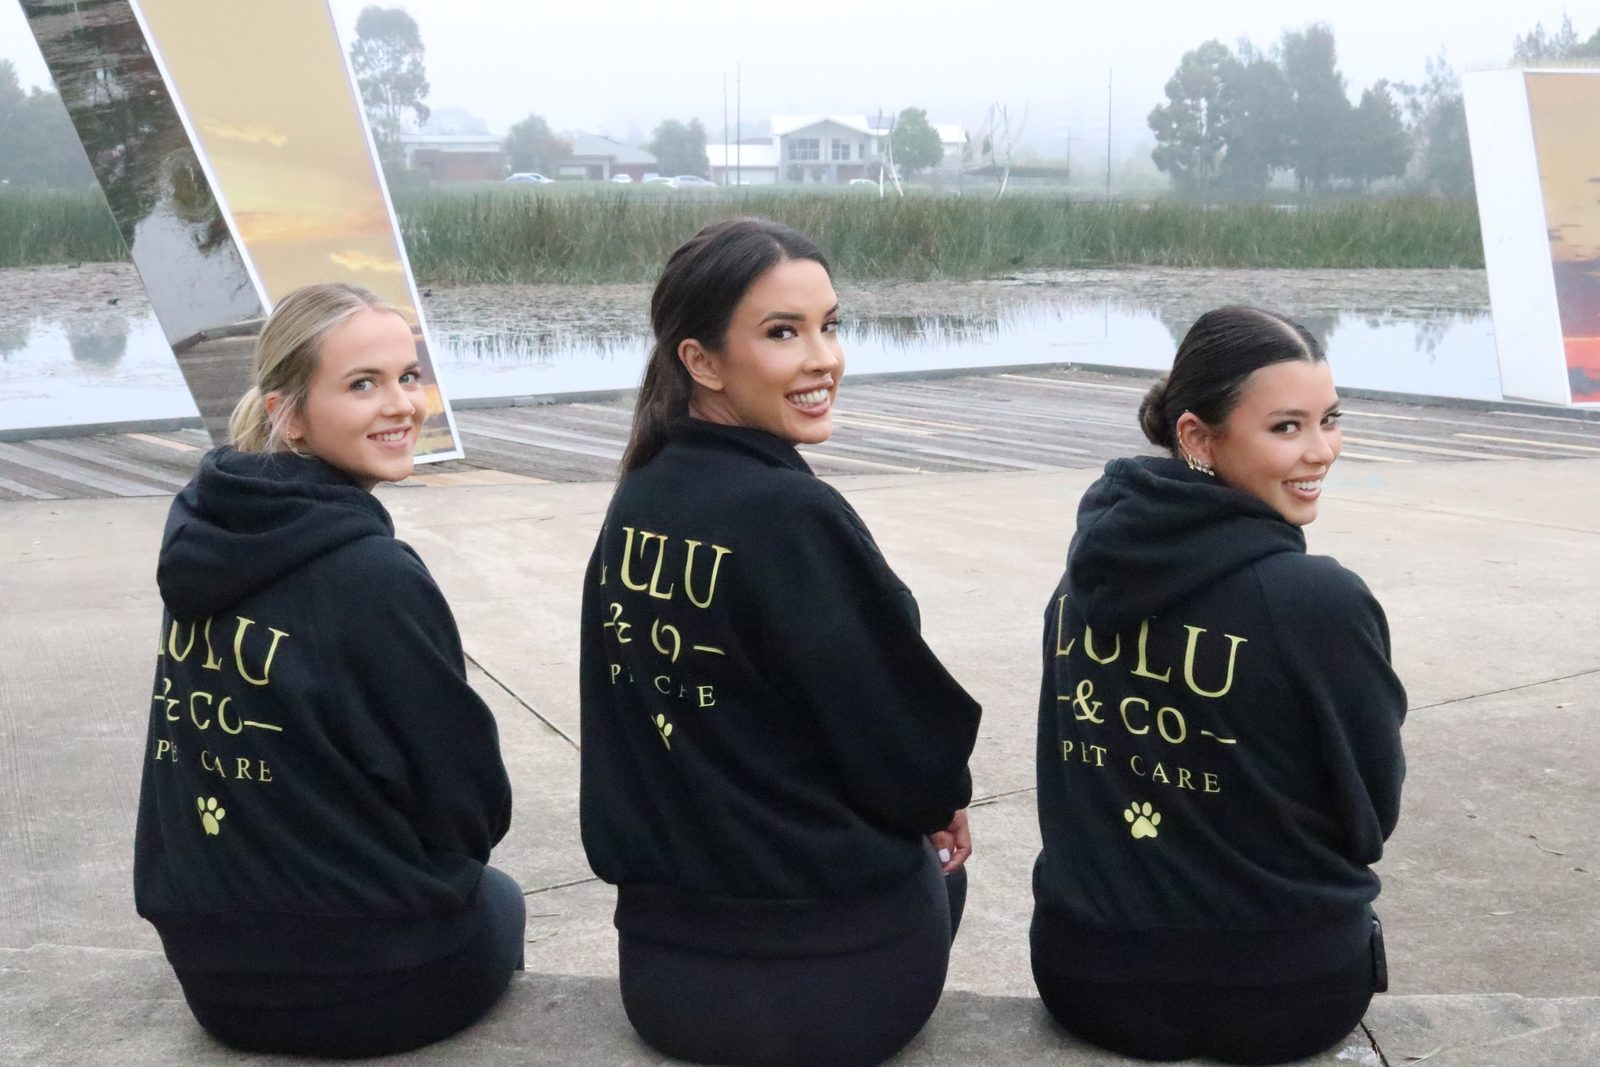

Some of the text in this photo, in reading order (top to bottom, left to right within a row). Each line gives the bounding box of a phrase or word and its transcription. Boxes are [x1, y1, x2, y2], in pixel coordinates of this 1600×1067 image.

[158, 614, 290, 686] ULU
[1056, 594, 1248, 698] LULU
[1119, 696, 1187, 744] CO
[1130, 755, 1220, 793] CARE
